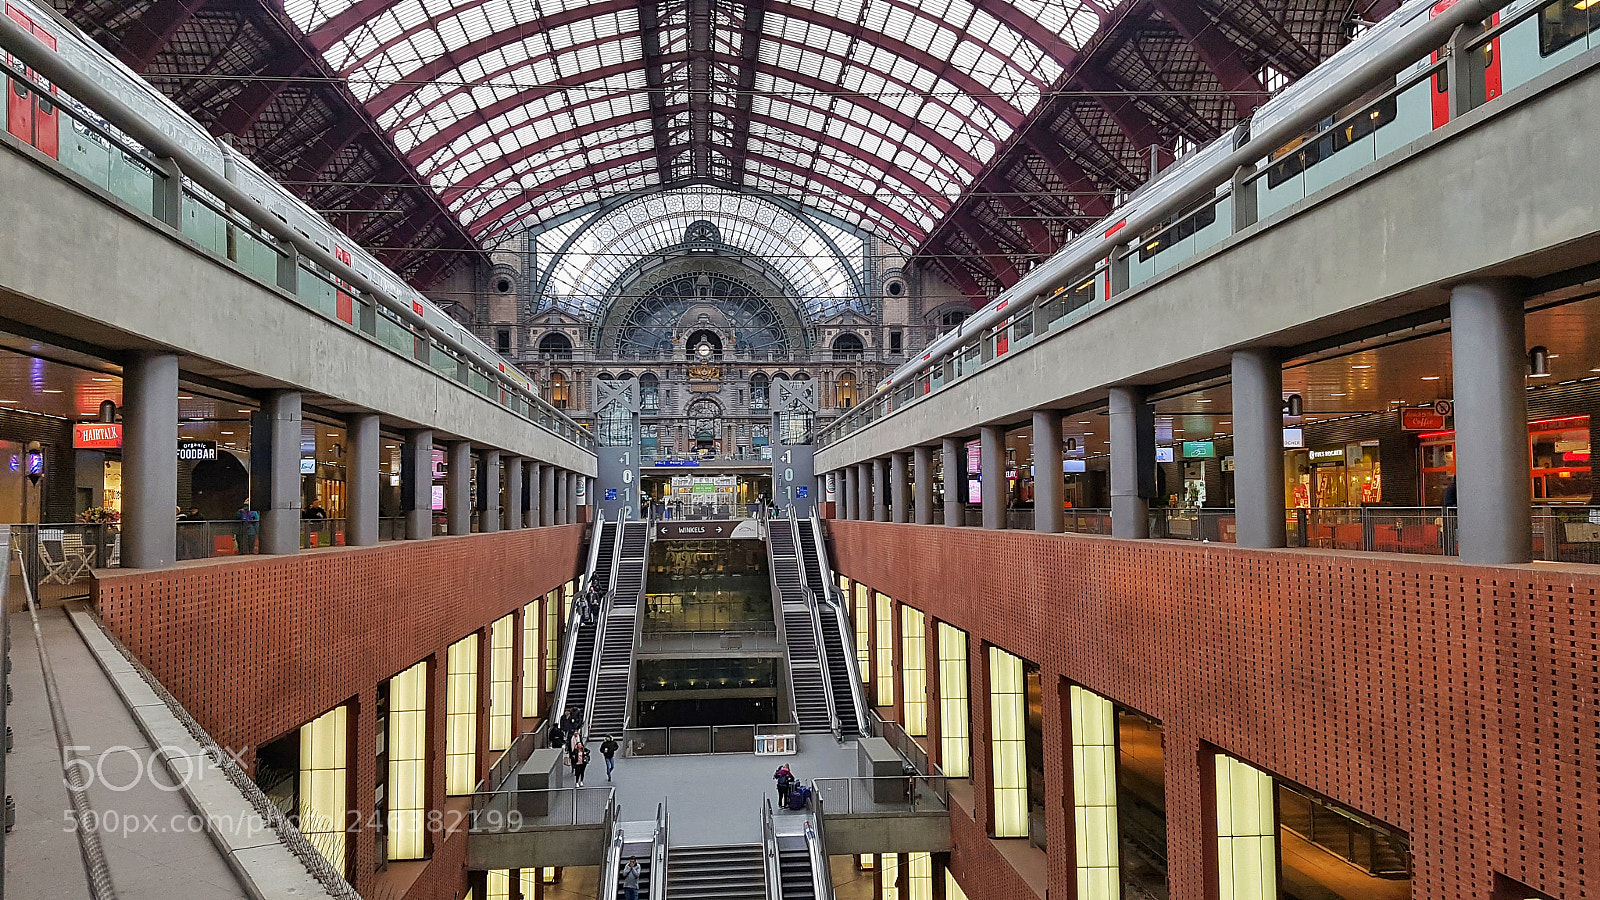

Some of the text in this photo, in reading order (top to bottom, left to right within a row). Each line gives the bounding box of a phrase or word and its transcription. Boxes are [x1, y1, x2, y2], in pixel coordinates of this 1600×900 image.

[83, 426, 118, 441] HAIRTALK
[177, 449, 214, 459] FOODBAR
[623, 469, 632, 483] 0
[785, 468, 793, 481] 0
